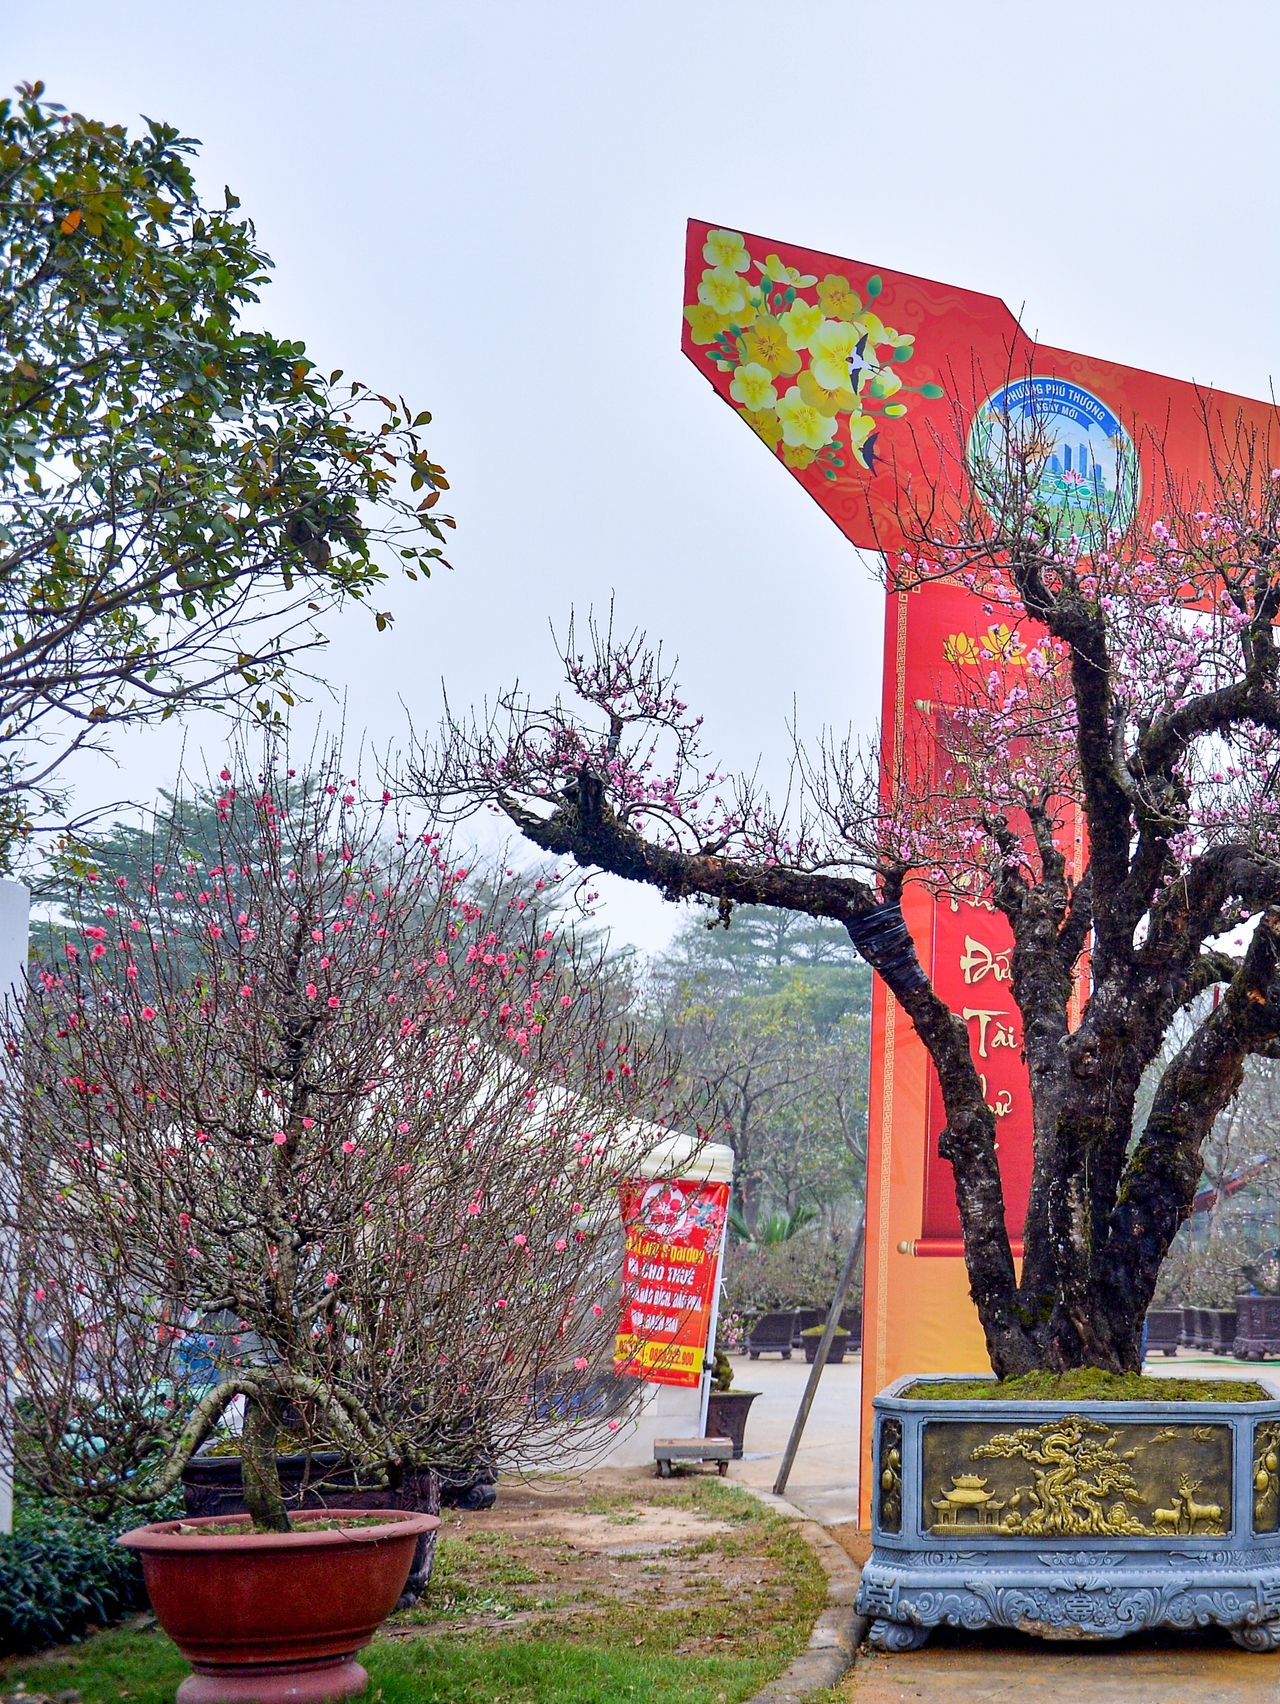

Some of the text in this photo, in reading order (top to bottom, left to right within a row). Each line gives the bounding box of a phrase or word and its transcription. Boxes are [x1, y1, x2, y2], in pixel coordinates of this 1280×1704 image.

[1045, 384, 1066, 397] PHÚ
[1068, 389, 1105, 421] THƯỢNG
[1061, 405, 1079, 420] MỚI
[960, 935, 1014, 984] Đứ
[963, 1007, 1018, 1057] Tài
